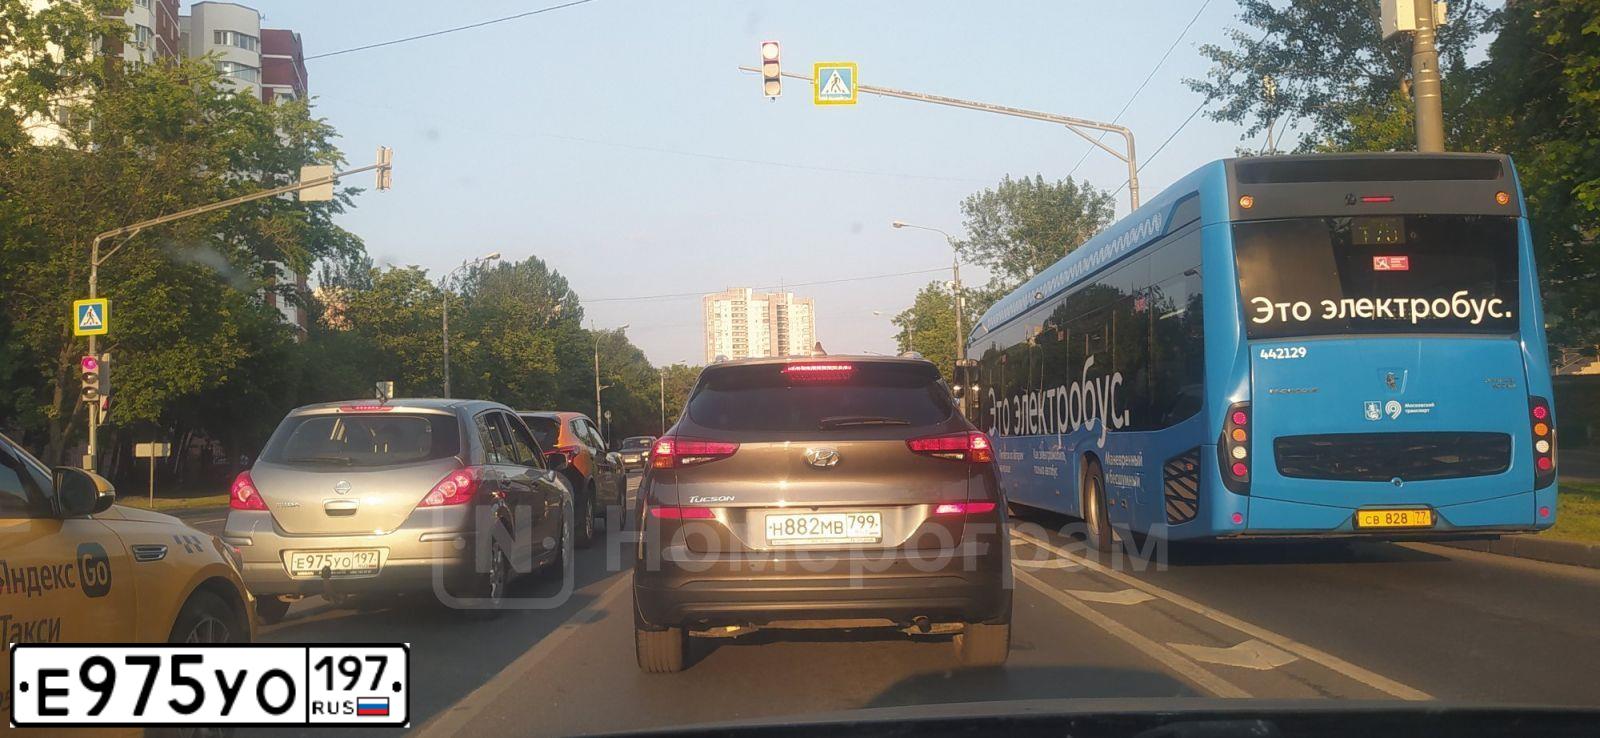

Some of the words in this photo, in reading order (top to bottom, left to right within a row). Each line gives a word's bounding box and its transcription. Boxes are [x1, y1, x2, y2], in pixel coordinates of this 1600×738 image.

[1250, 296, 1312, 324] Это
[1320, 290, 1512, 324] электробус.
[1260, 346, 1307, 359] 442129
[988, 387, 1010, 437] Это
[1013, 354, 1130, 450] электробус.
[773, 517, 843, 536] Н882МВ
[847, 515, 875, 529] 799
[1365, 515, 1380, 525] СВ
[1385, 513, 1408, 525] 828
[1414, 512, 1426, 521] 77
[82, 553, 108, 586] Go
[296, 554, 351, 569] Е975УО
[354, 552, 375, 563] 197
[0, 559, 76, 598] Яндекс
[0, 614, 61, 648] Такси
